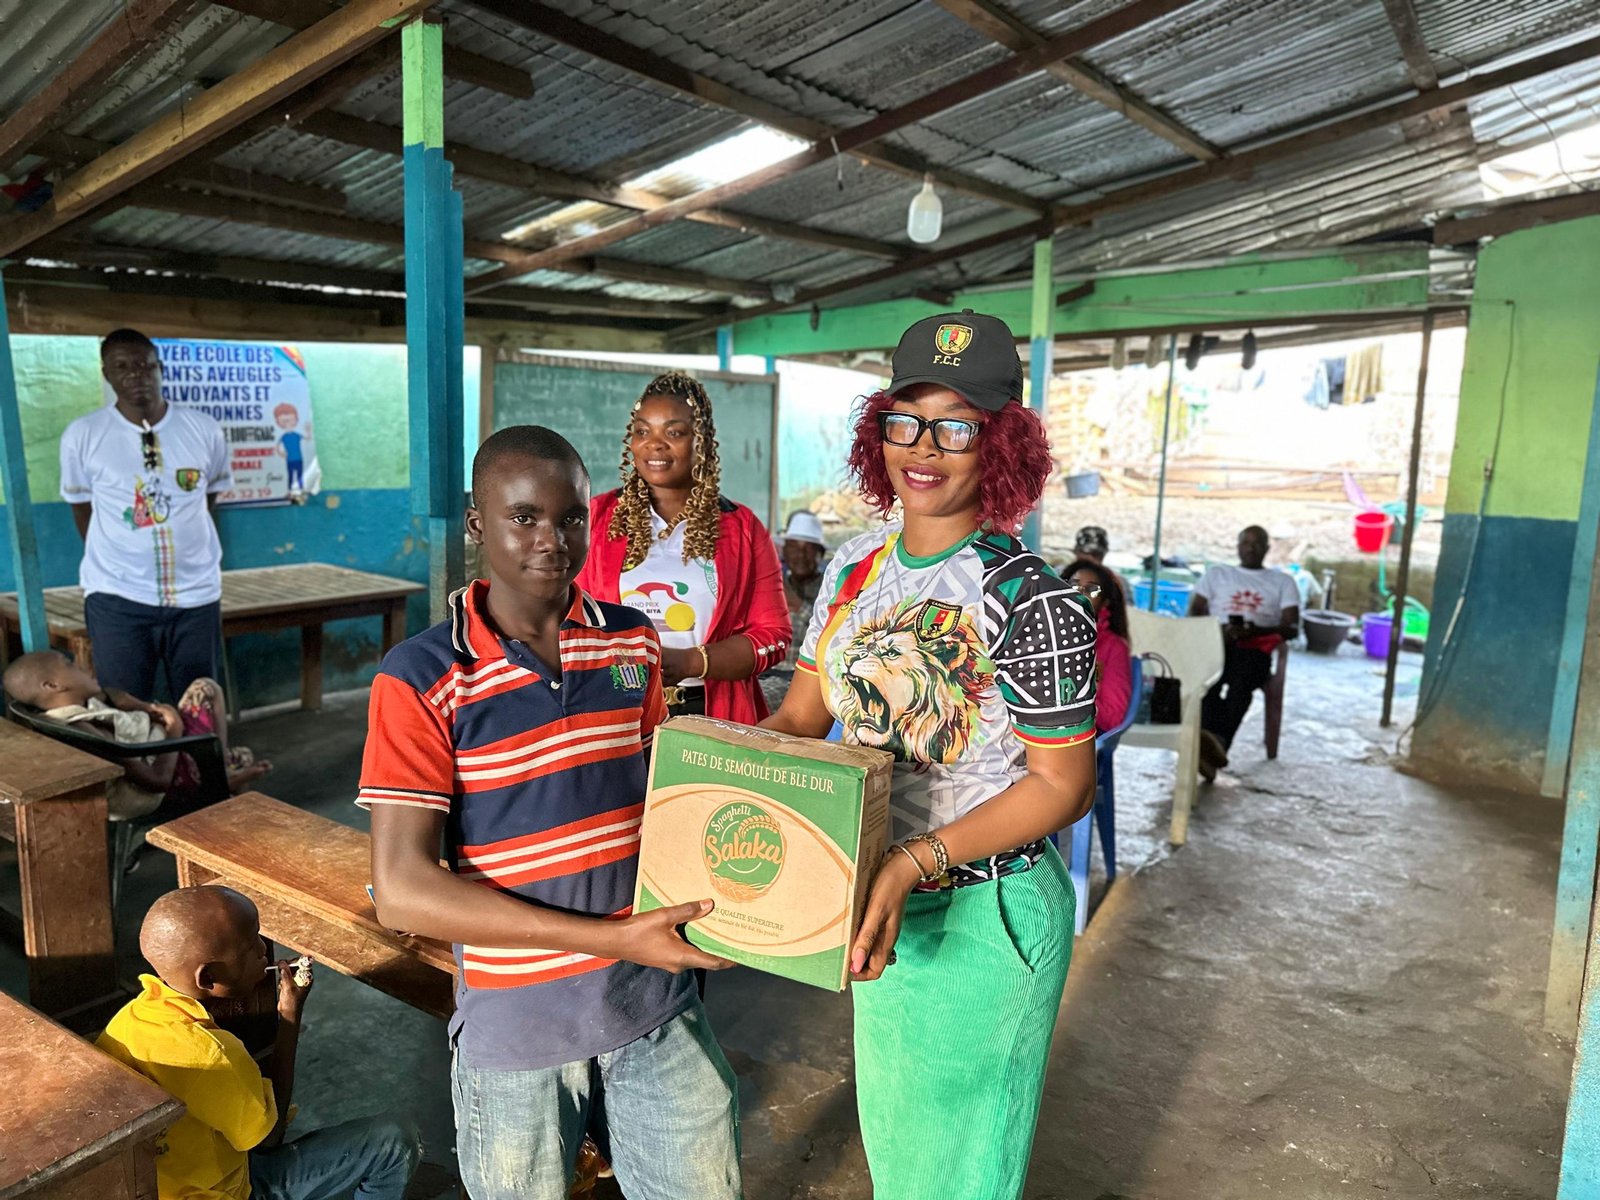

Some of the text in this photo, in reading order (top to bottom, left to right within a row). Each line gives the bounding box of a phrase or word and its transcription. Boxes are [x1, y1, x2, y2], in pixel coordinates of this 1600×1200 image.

[161, 345, 273, 363] YER ECOLE DES
[162, 365, 282, 382] ANTS AVEUGLES
[161, 386, 271, 402] ALVOYANTS ET
[681, 748, 834, 794] PATES DE SEMOULE DE BLE DUR
[710, 804, 751, 832] Spaghetti
[704, 831, 784, 869] Salaka
[720, 908, 747, 921] QUALITE
[747, 915, 785, 931] SUPERIEURE
